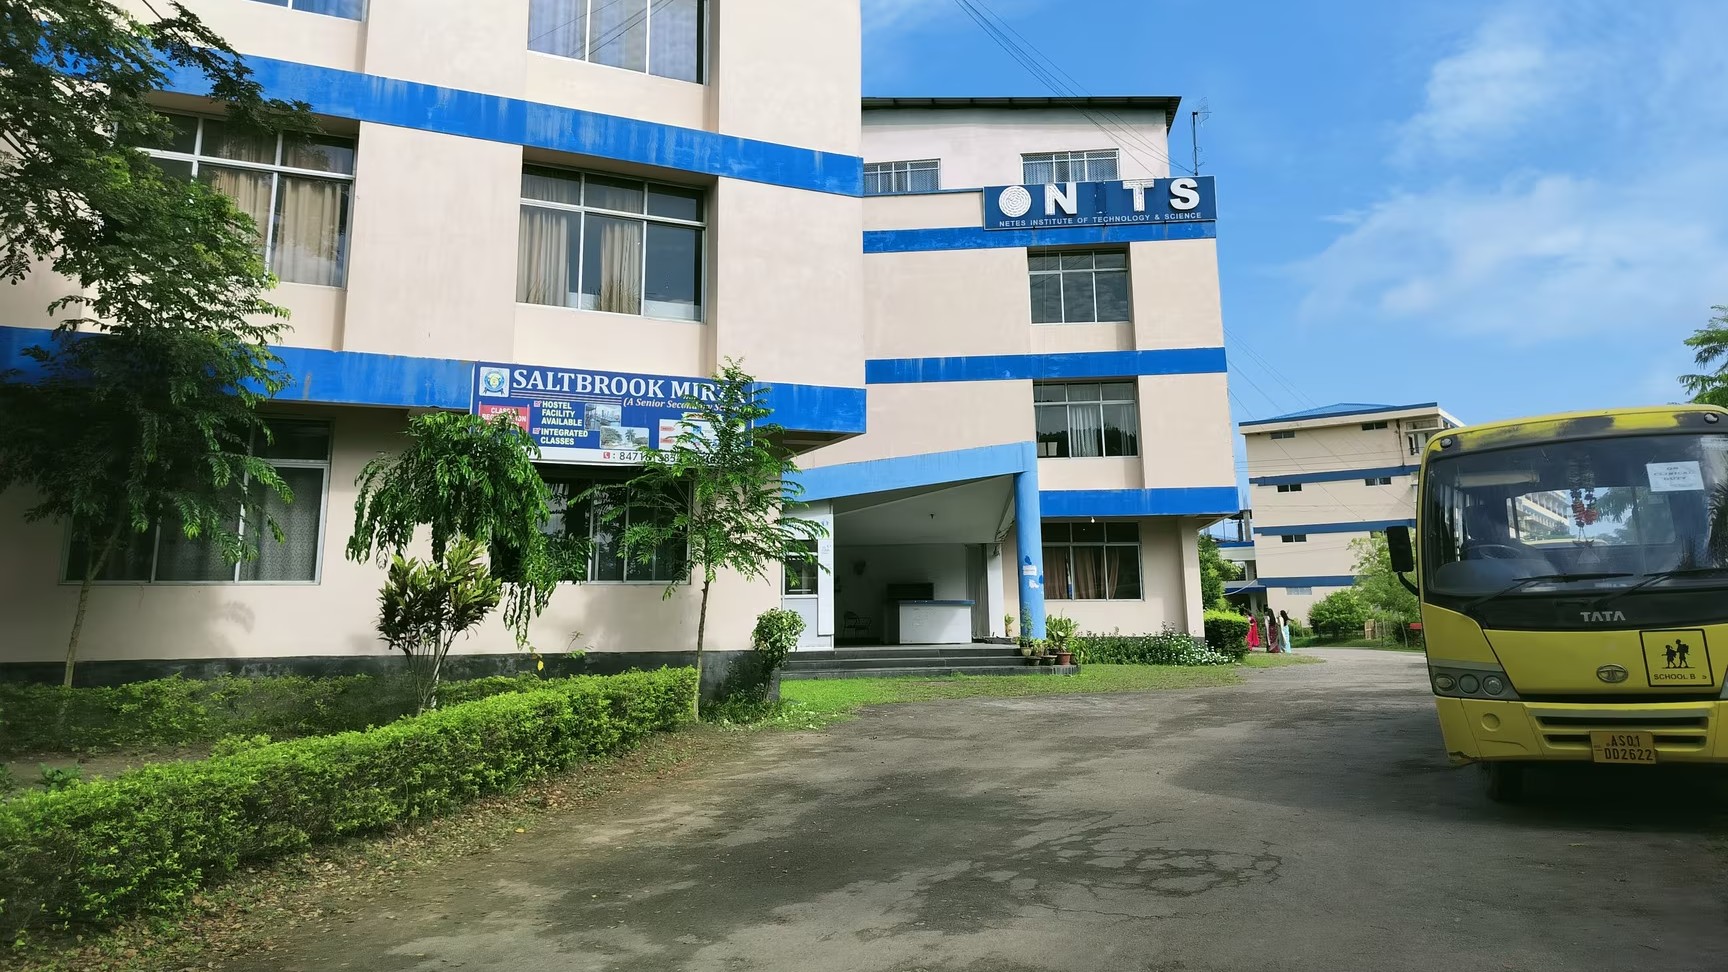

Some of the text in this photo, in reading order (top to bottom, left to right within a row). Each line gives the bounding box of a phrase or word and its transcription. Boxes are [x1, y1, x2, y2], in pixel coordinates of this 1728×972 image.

[999, 219, 1026, 227] NETES
[1030, 217, 1073, 226] INSTITUTE
[1077, 216, 1088, 224] OF
[1092, 214, 1150, 223] TECHNOLOGY
[1164, 212, 1202, 220] SCIENCE
[512, 369, 665, 398] SALTBROOK
[542, 400, 572, 410] HOSTEL
[636, 398, 665, 408] Senior
[541, 408, 576, 418] FACILITY
[541, 417, 583, 427] AVAILABLE
[540, 428, 589, 437] INTEGRATED
[540, 436, 575, 446] CLASSES
[1580, 610, 1626, 622] TATA
[1611, 734, 1641, 747] AS01
